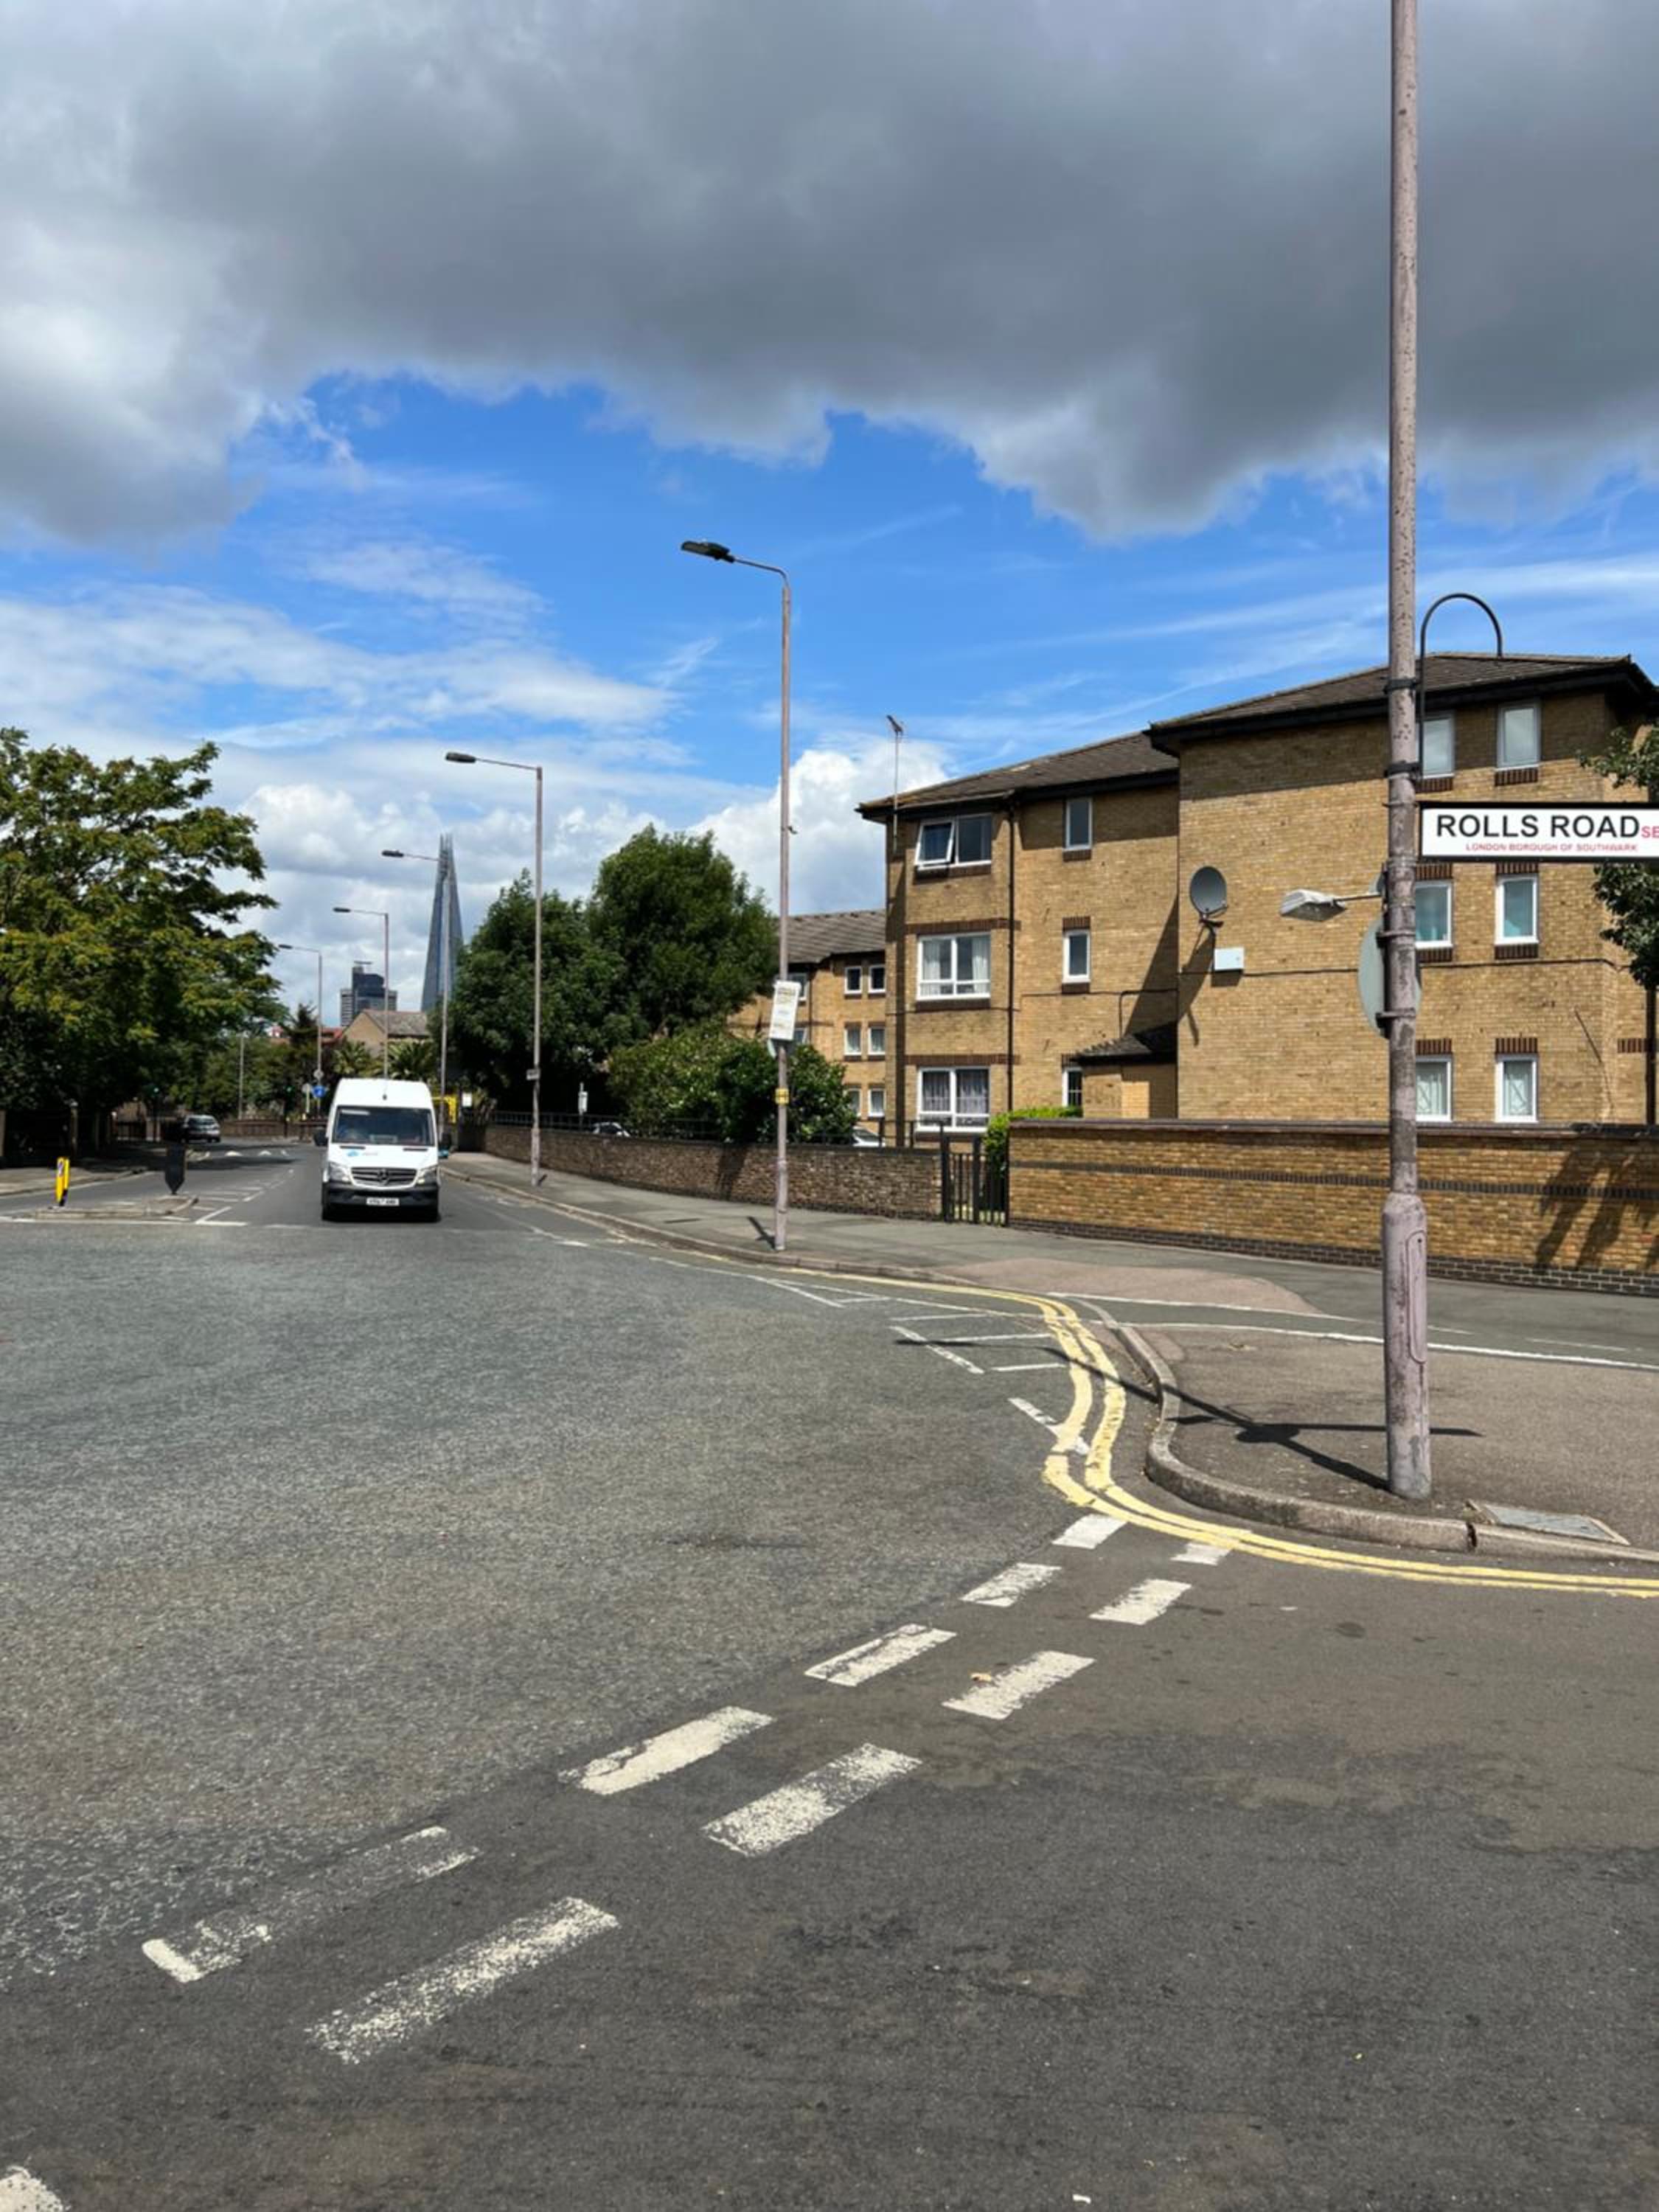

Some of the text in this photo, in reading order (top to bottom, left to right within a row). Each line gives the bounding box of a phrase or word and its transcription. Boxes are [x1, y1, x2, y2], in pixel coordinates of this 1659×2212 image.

[1437, 815, 1539, 838] ROLLS
[1551, 815, 1641, 838] ROAD
[1465, 843, 1507, 851] LONDON
[1508, 843, 1558, 851] BOROUGH
[1576, 844, 1638, 852] SOUTHWARK
